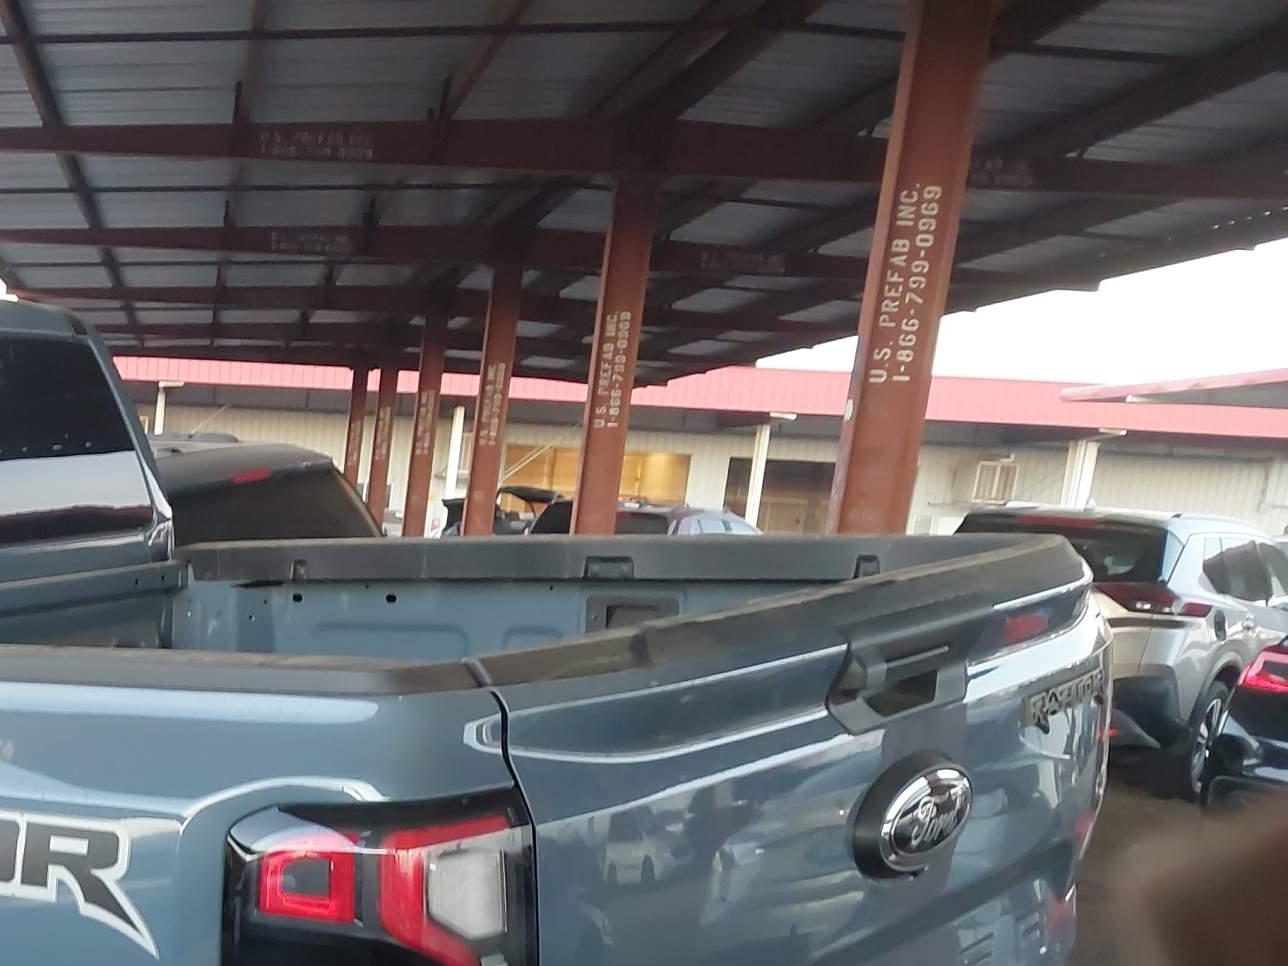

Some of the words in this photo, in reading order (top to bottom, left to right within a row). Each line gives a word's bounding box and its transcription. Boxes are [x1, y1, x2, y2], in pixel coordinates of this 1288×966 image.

[896, 182, 921, 226] INC.
[879, 238, 911, 328] PREFAB
[892, 185, 943, 382] 1-866-799-0969
[868, 340, 895, 384] U.S.
